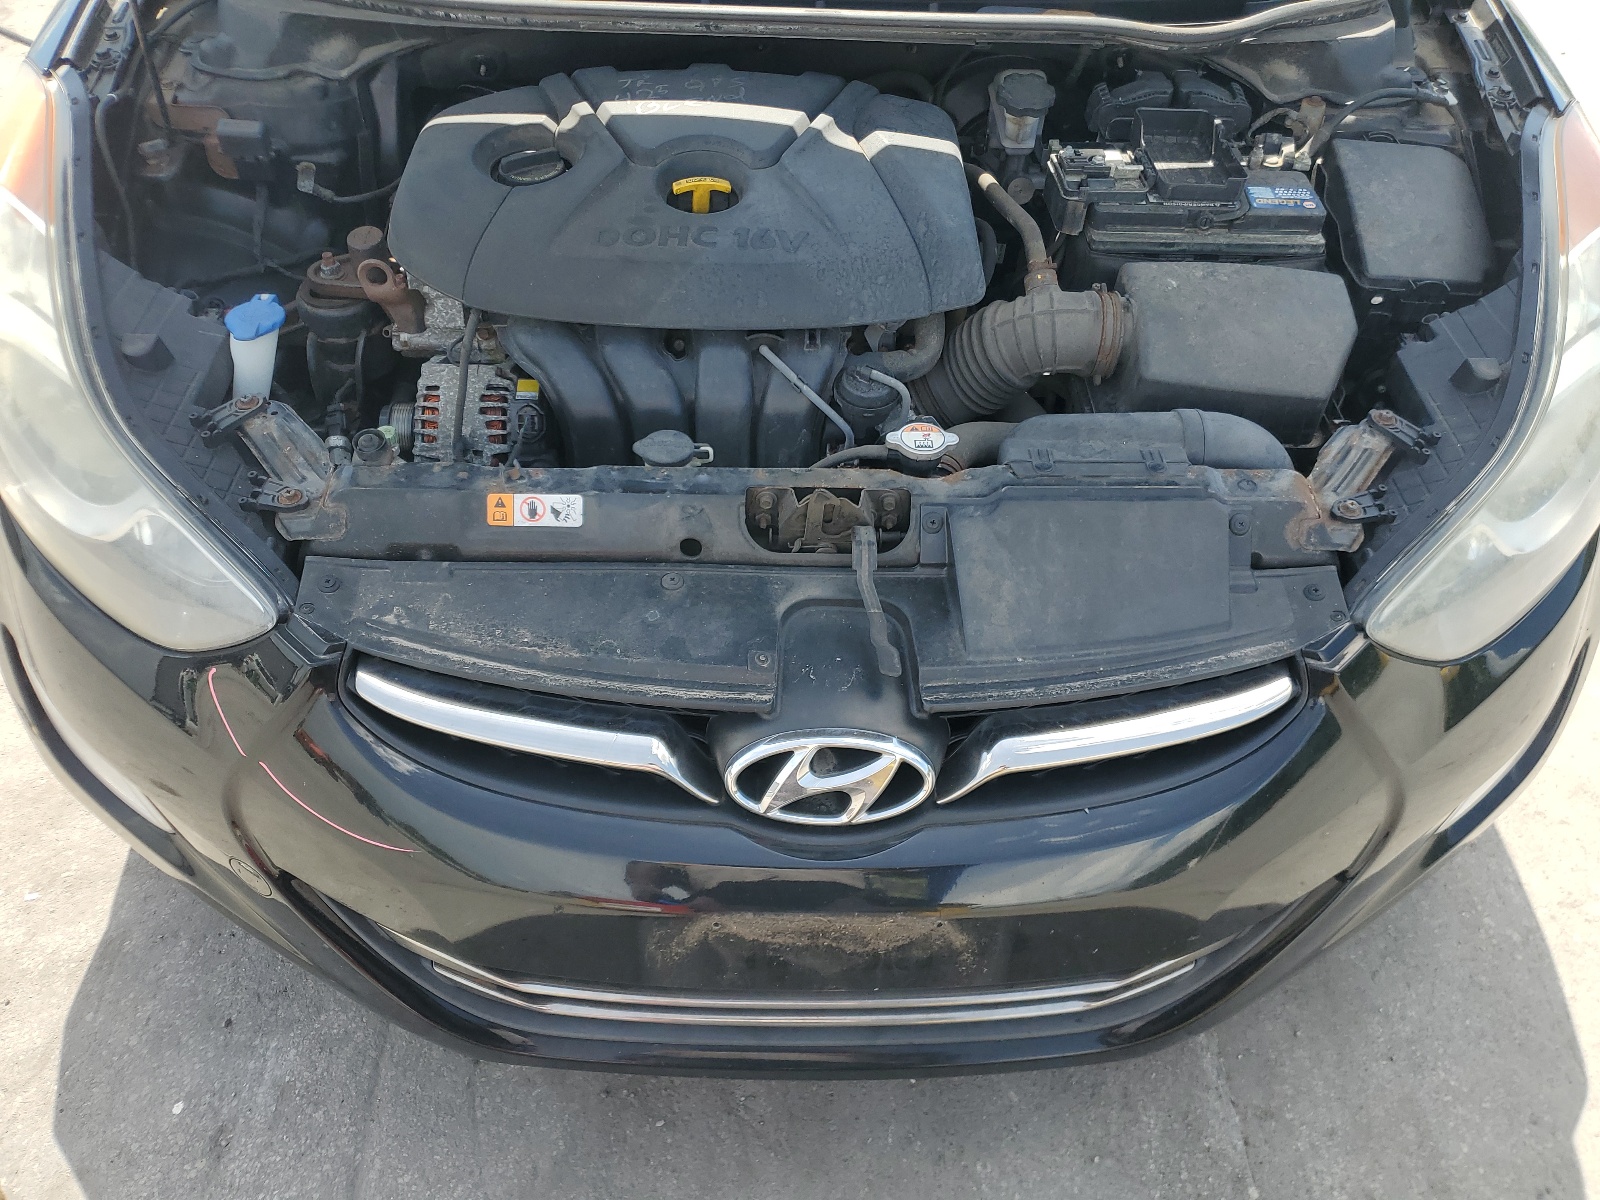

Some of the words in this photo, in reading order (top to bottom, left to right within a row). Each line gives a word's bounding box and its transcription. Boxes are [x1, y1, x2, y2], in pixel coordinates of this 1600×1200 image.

[1255, 198, 1302, 207] LEGEND
[596, 225, 718, 248] DOHC
[733, 225, 810, 254] 16V
